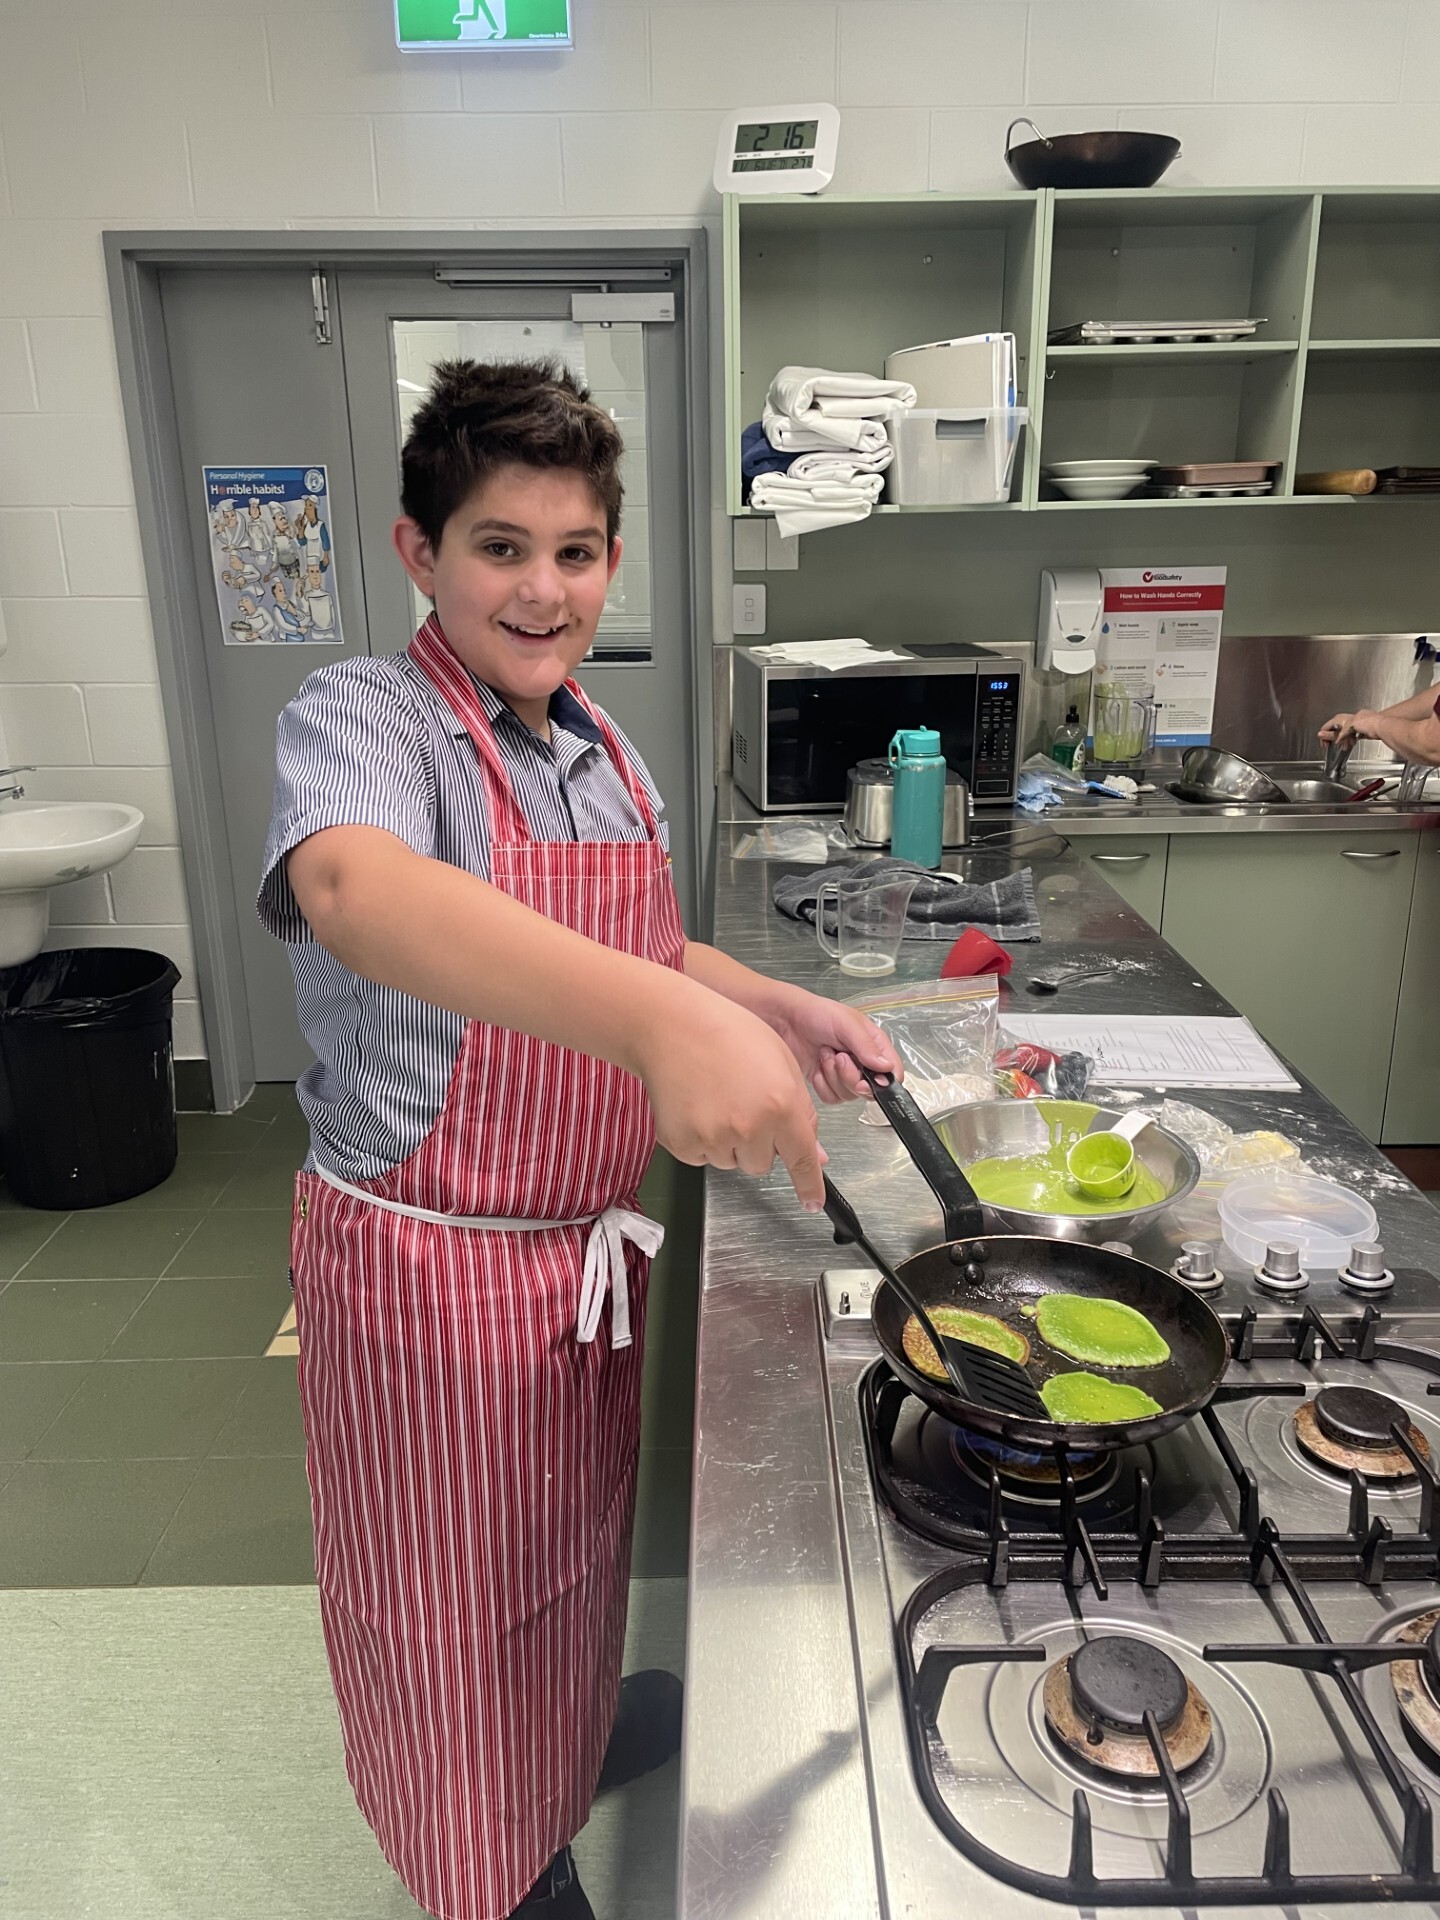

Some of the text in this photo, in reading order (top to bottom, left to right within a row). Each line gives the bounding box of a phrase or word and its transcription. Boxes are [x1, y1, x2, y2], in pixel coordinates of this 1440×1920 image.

[209, 472, 265, 481] Personal Hygiene
[210, 483, 285, 495] Horrible habits!
